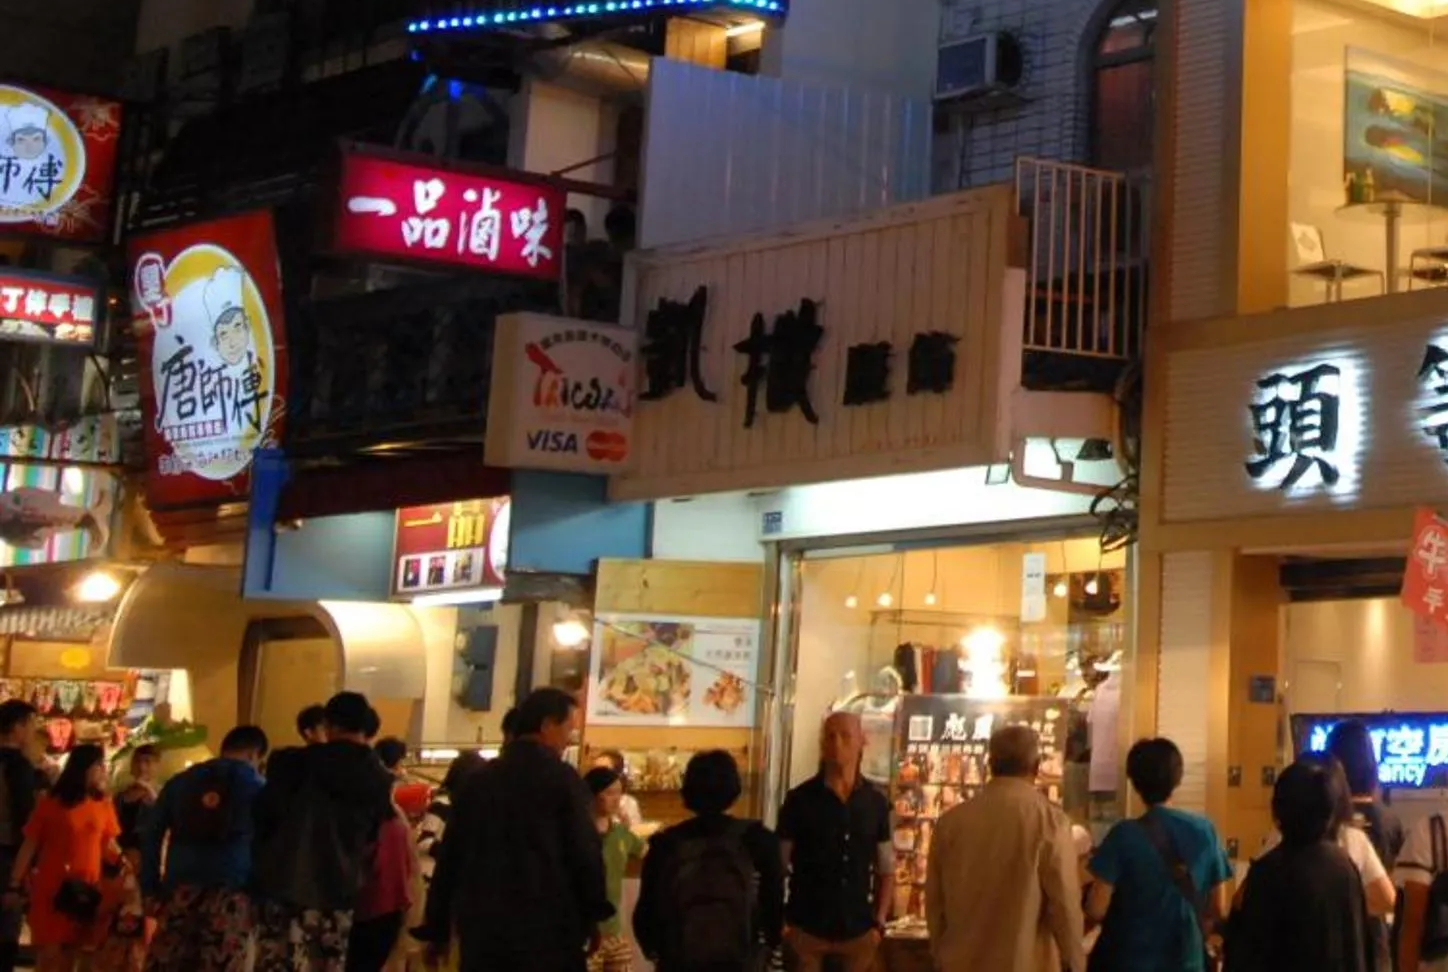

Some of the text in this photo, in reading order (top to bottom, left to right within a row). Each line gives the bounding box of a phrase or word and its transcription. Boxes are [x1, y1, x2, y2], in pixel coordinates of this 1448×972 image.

[348, 178, 553, 268] 一品滷味
[156, 334, 270, 436] 唐師傅
[526, 429, 579, 454] VISA
